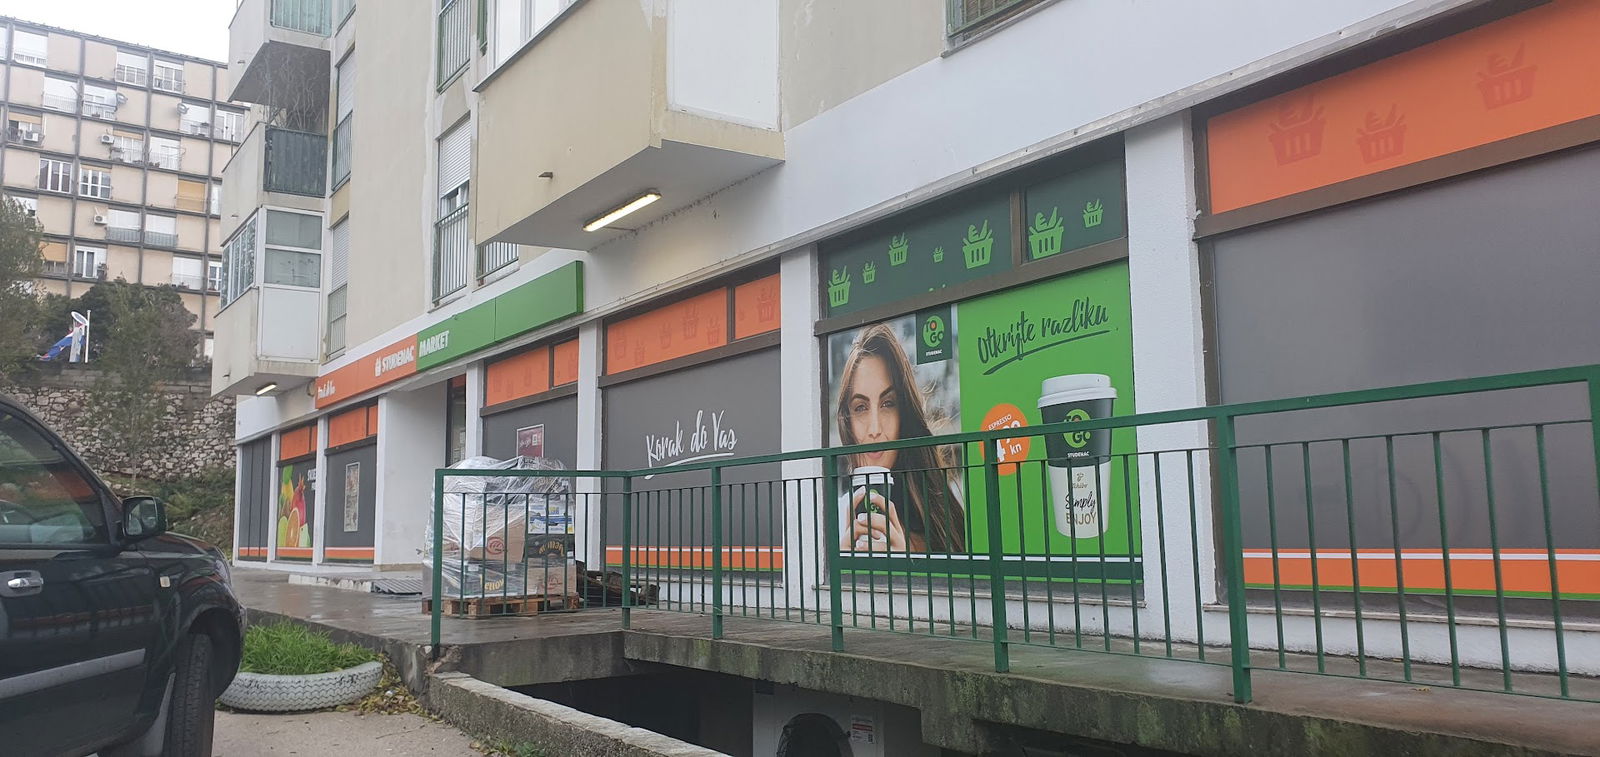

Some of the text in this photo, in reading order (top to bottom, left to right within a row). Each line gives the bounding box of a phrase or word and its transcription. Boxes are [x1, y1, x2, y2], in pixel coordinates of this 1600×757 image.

[381, 330, 450, 373] STUDENAC MARKET
[930, 331, 944, 344] GO
[977, 296, 1109, 364] Otkrijte razliku
[646, 409, 738, 468] Korak do Vas
[1010, 443, 1023, 455] kn
